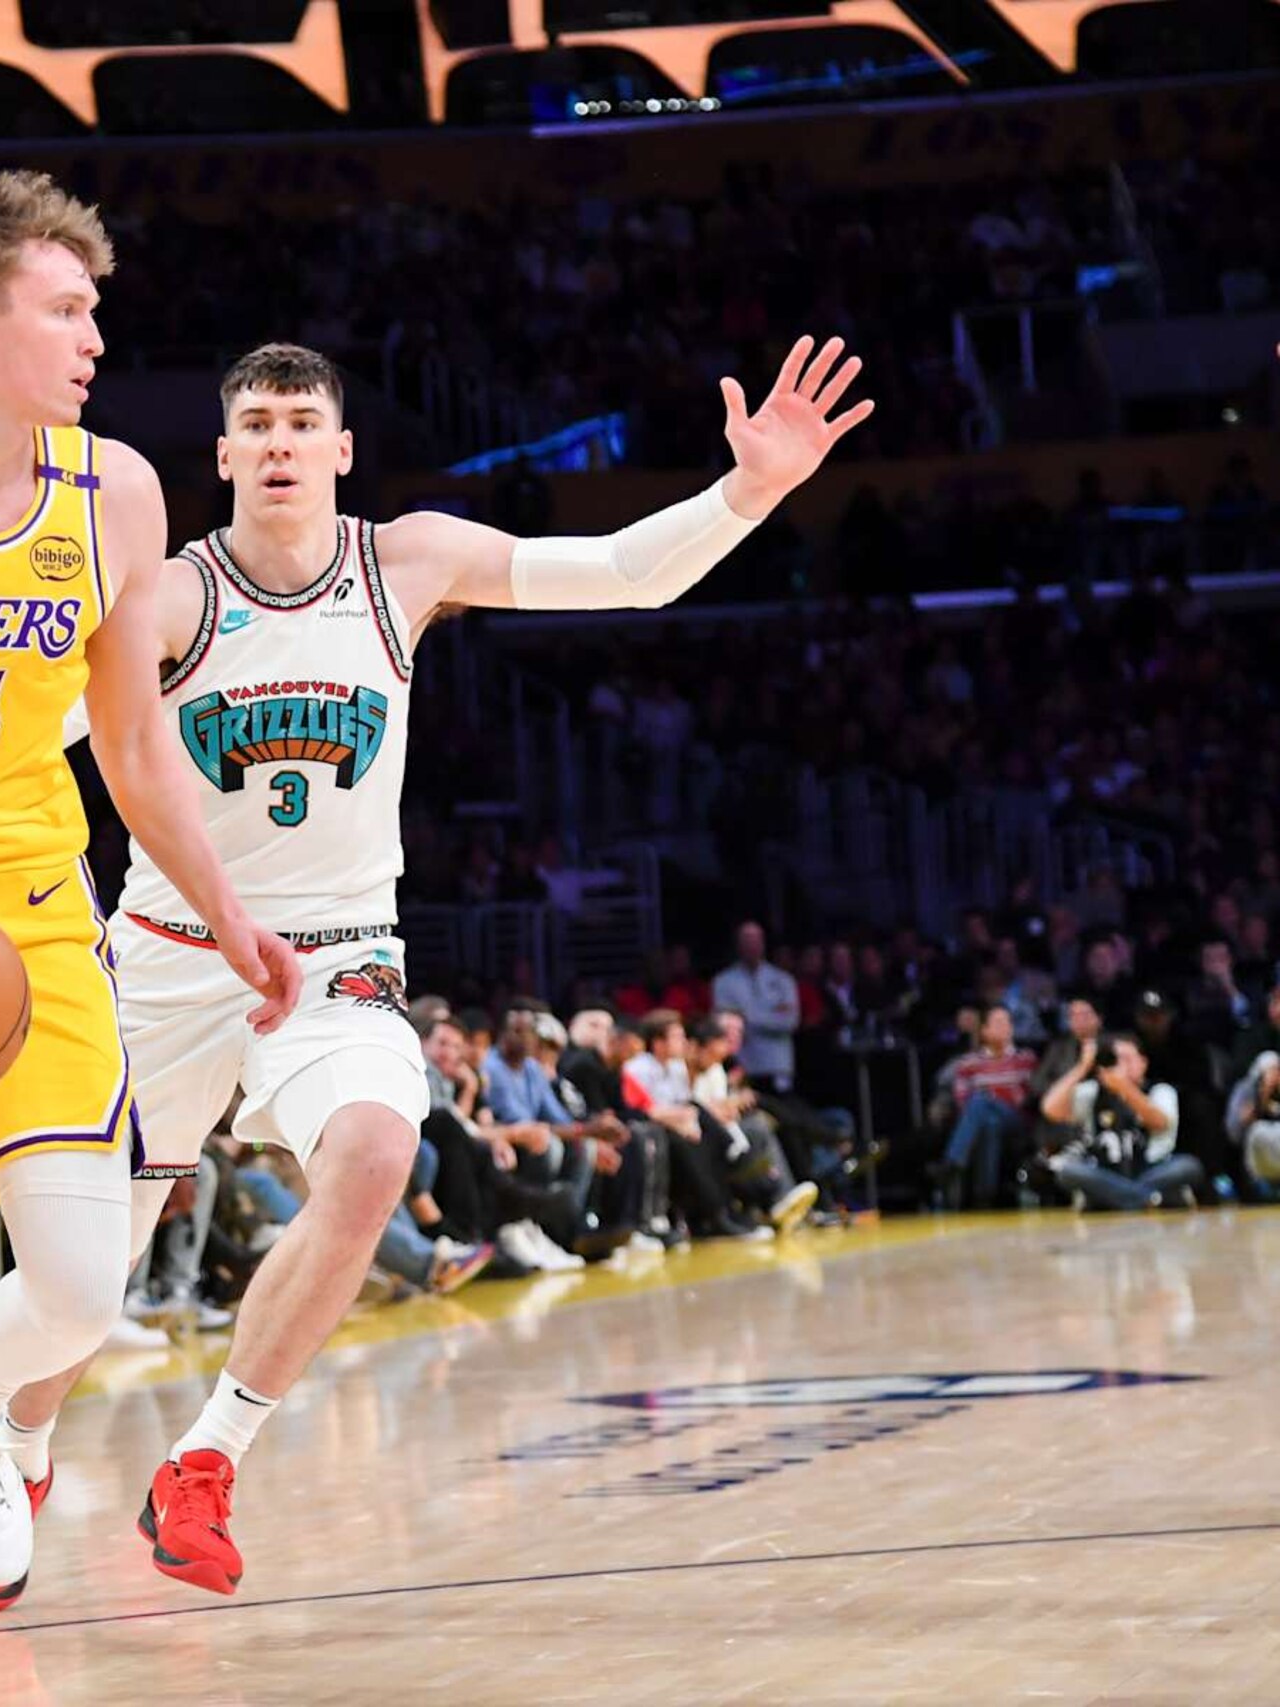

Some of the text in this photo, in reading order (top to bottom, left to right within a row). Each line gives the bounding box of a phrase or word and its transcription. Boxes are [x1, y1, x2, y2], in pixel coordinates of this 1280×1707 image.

[34, 548, 81, 569] bibigo
[226, 680, 349, 700] VANCOUVER
[179, 685, 389, 793] GRIZZLIES
[268, 770, 309, 828] 3
